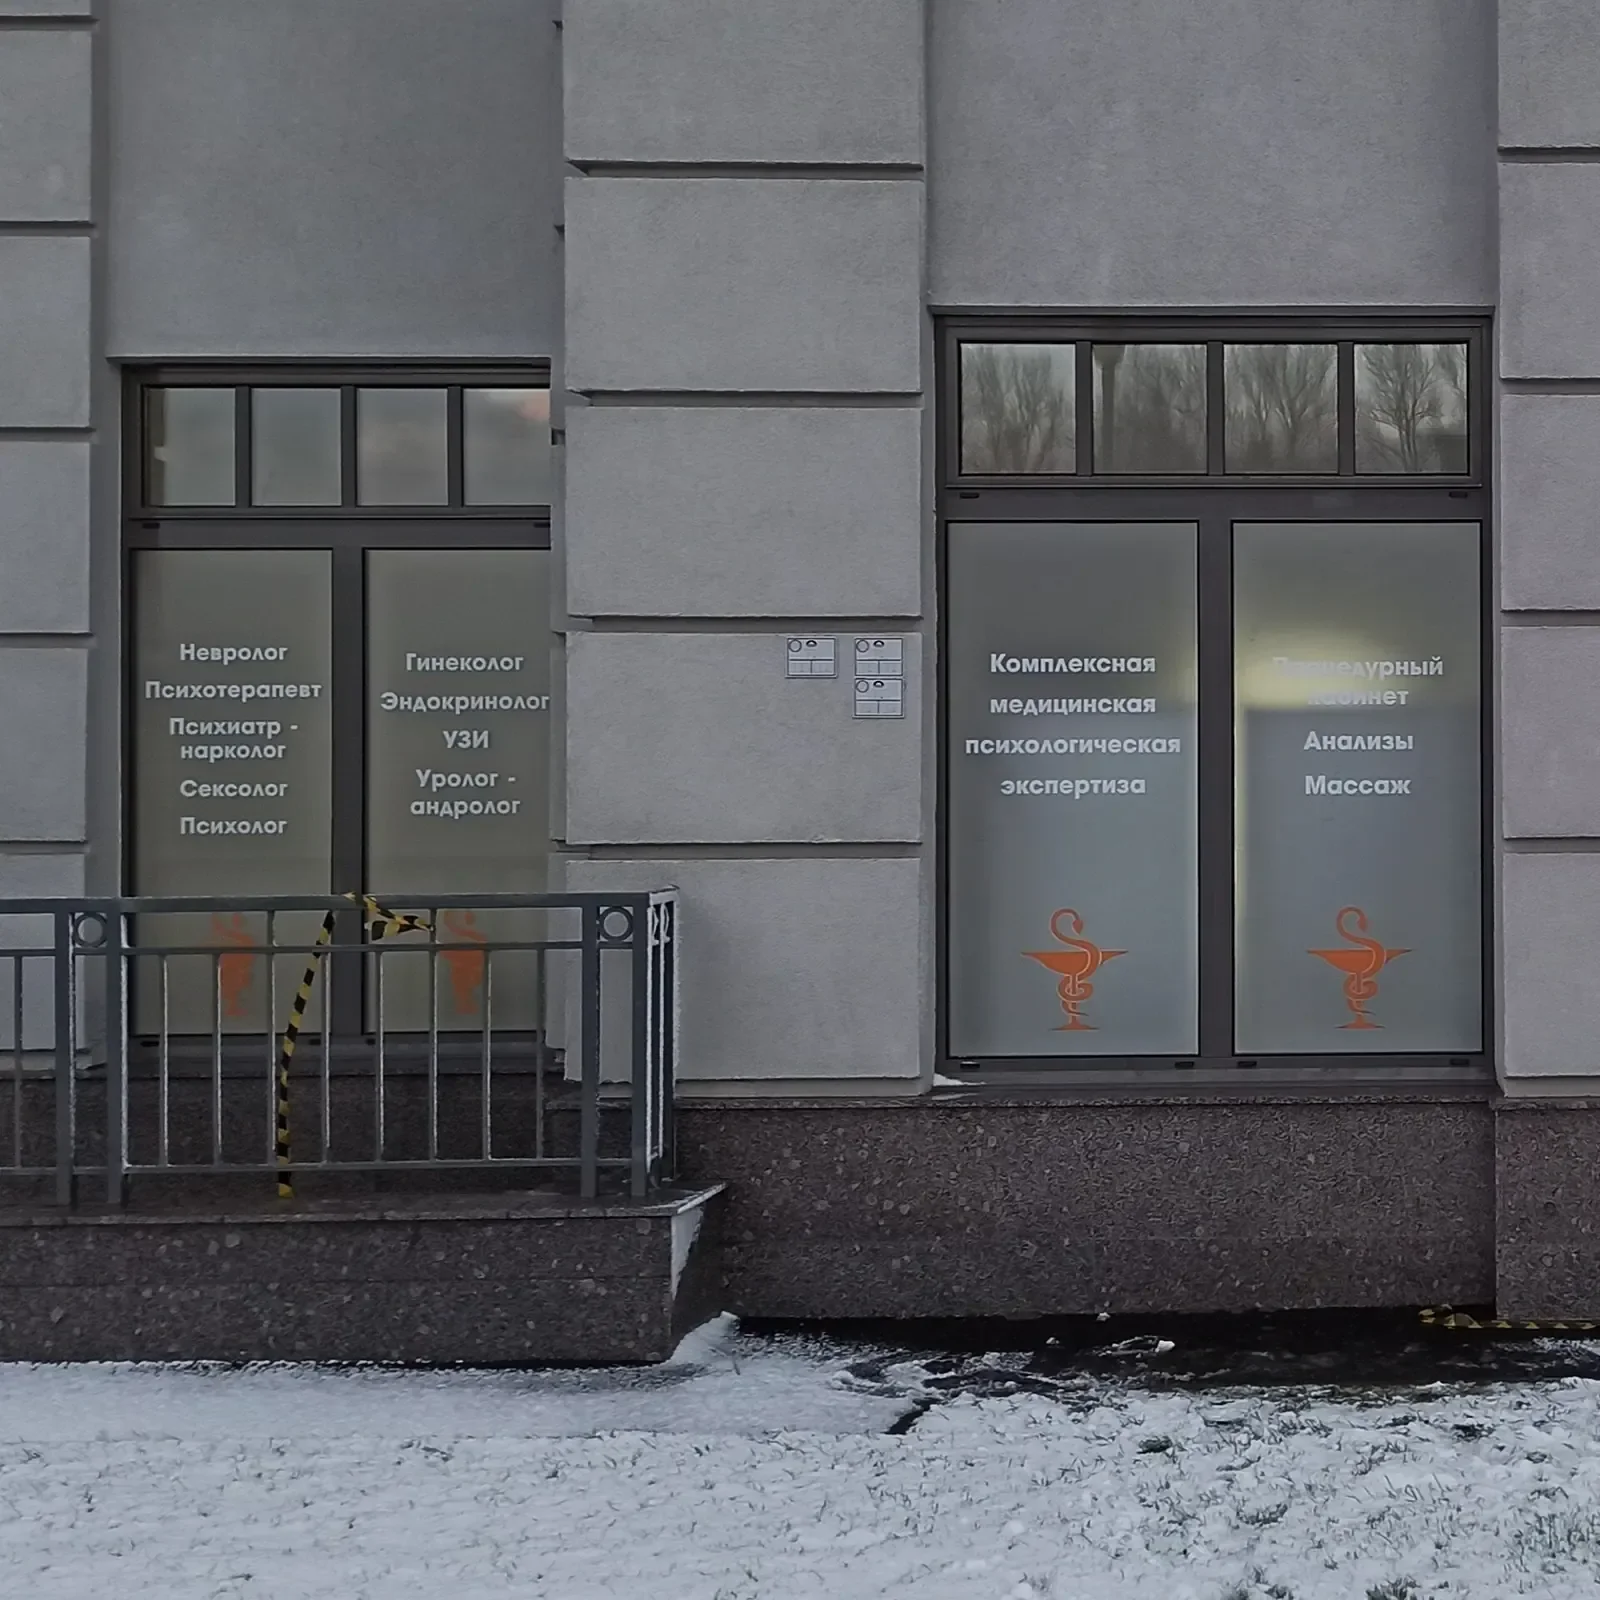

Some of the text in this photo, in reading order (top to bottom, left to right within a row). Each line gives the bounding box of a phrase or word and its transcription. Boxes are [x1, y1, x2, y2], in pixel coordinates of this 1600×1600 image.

[179, 643, 288, 666] Невролог
[405, 652, 524, 671] Гинеколог
[990, 653, 1156, 673] Комплексная
[1272, 655, 1444, 680] Пцедурный
[145, 680, 322, 703] Психотерапевт
[380, 691, 550, 715] Эндокринолог
[990, 697, 1156, 716] медицинская
[169, 717, 281, 739] Психиатр
[442, 730, 489, 749] УЗИ
[965, 738, 1181, 754] психологическая
[1303, 730, 1414, 750] Анализы
[180, 745, 286, 763] нарколог
[179, 779, 288, 797] Сексолог
[415, 769, 499, 792] Уролог
[1000, 778, 1146, 799] экспертиза
[1304, 775, 1412, 795] Массаж
[410, 800, 521, 820] андролог
[179, 816, 288, 835] Психолог
